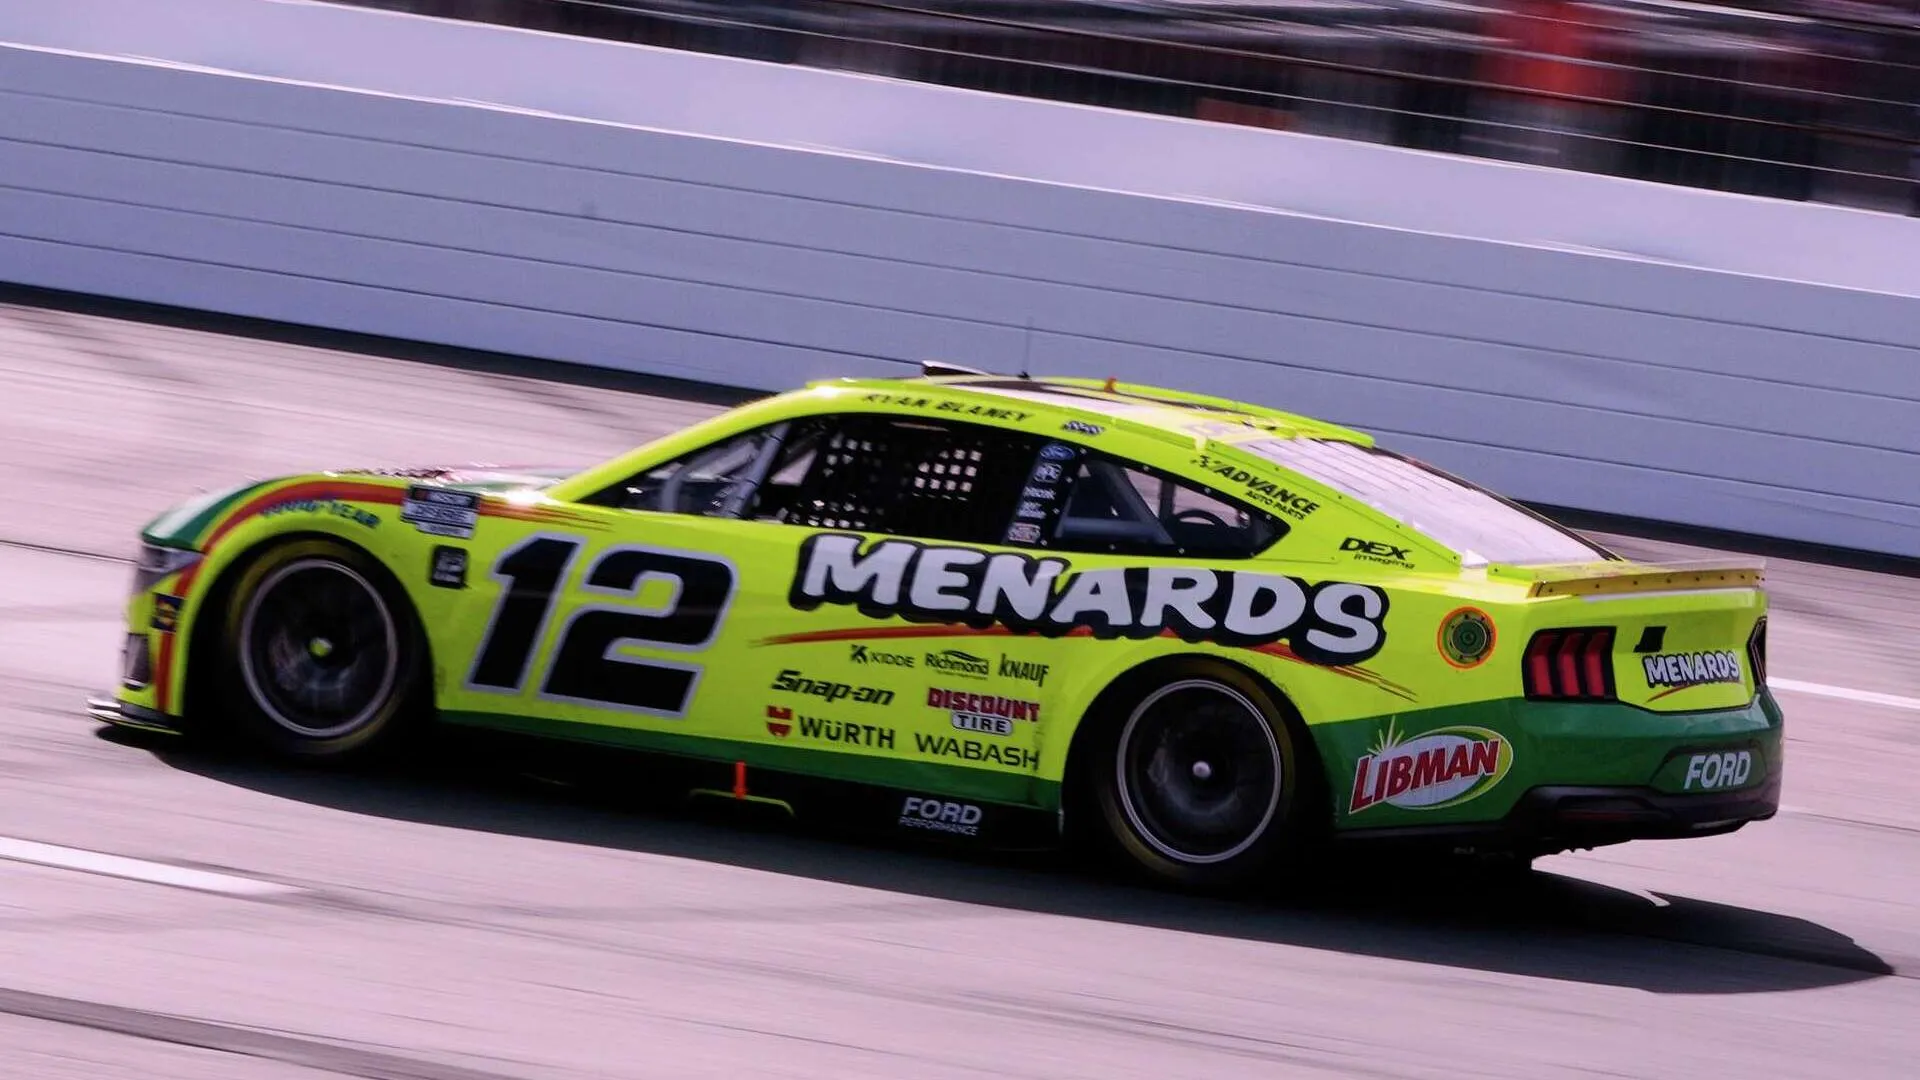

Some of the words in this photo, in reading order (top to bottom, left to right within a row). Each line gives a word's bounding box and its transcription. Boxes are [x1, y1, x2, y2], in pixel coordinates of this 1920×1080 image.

[1214, 464, 1320, 515] ADVANCE
[1244, 490, 1274, 507] AUTO
[1339, 536, 1412, 560] DEX
[802, 533, 1383, 658] MENARDS
[468, 533, 740, 717] 12
[872, 651, 916, 668] KIDDE
[925, 653, 989, 675] Richmond
[998, 653, 1050, 687] KNAUF
[1645, 651, 1739, 685] MENARDS
[771, 669, 895, 706] Snap-on
[927, 687, 1041, 722] DISCOUNT
[958, 714, 1006, 733] TIRE
[915, 733, 1041, 771] WABASH
[1350, 740, 1501, 813] LIBMAN
[1684, 751, 1751, 790] FORD
[901, 816, 978, 836] PERFORMANCE
[902, 797, 982, 825] FORD
